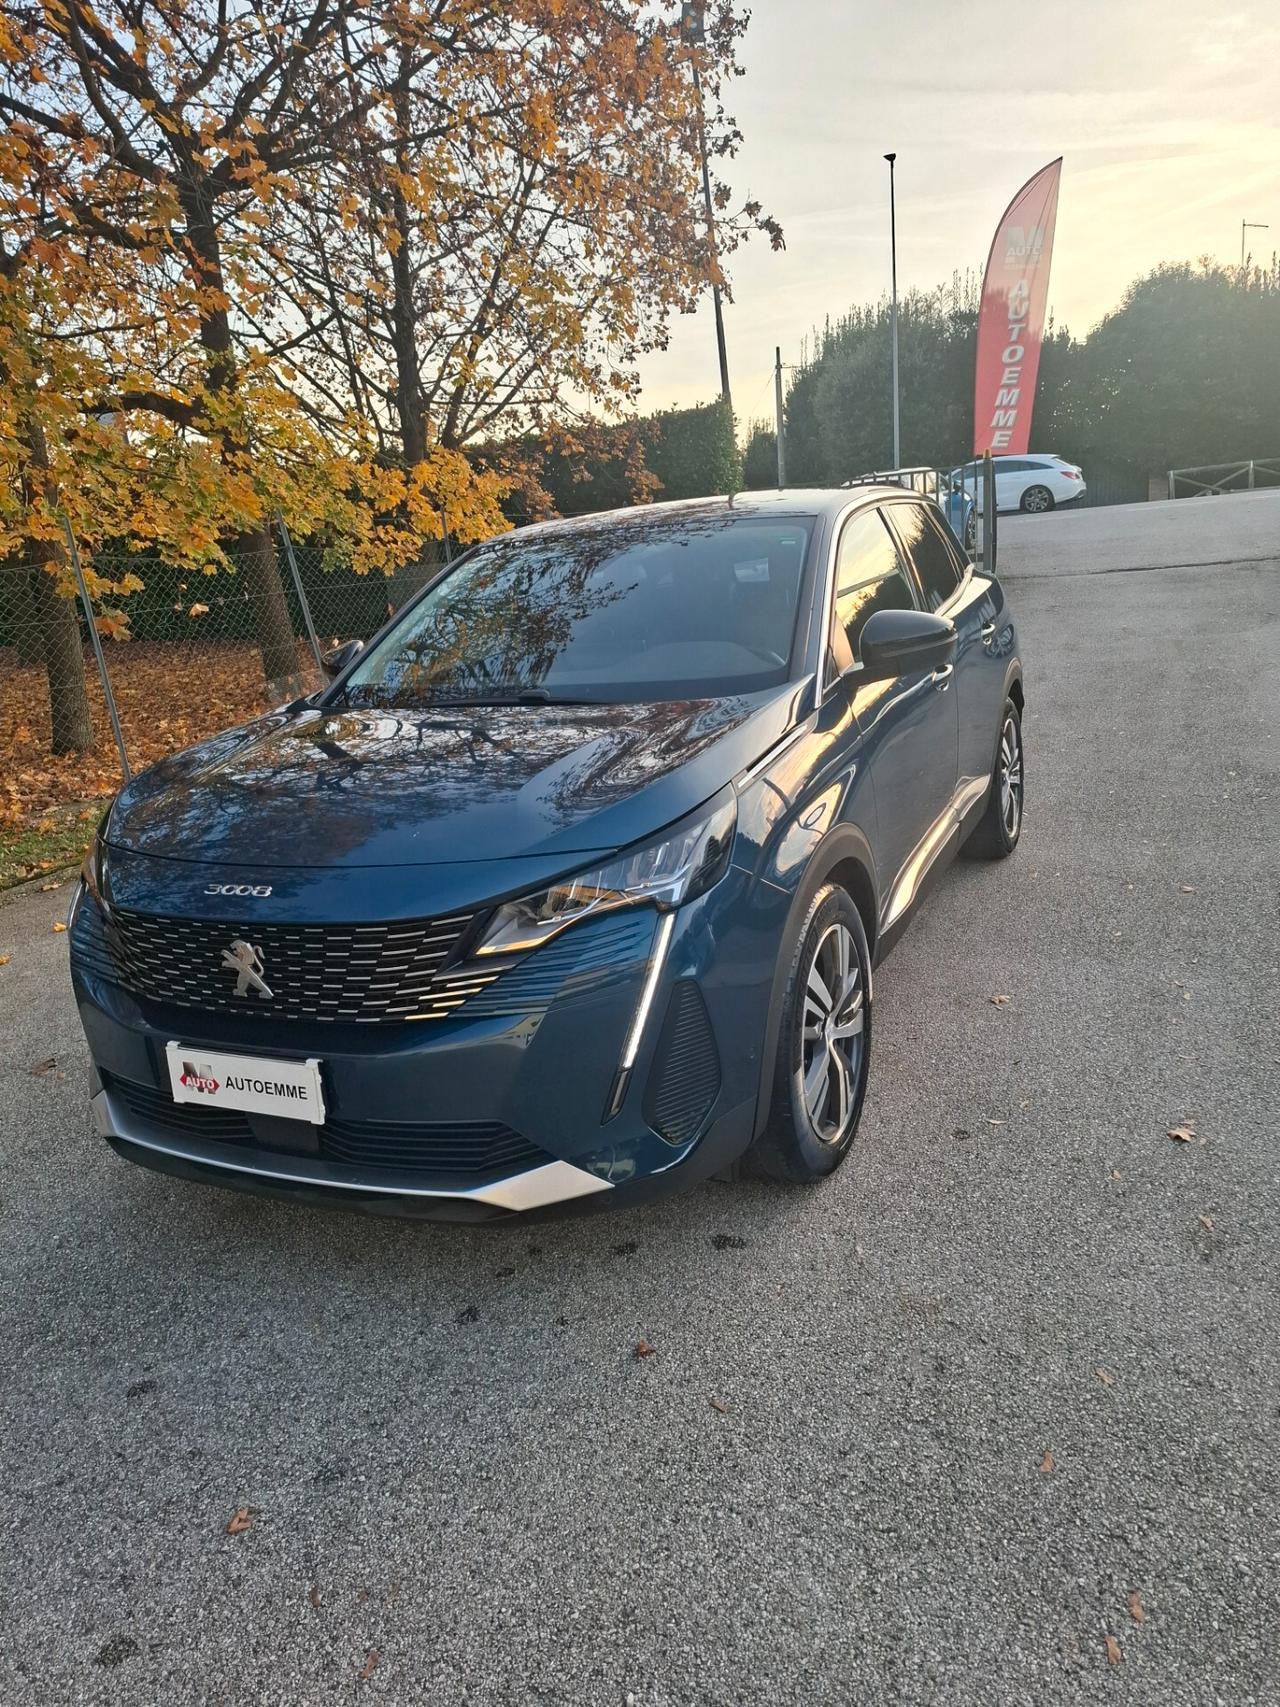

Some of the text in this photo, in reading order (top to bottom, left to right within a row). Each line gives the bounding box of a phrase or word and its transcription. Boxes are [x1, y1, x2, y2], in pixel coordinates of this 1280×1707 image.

[991, 279, 1029, 449] AUTOEMME
[203, 883, 273, 897] 3008
[185, 1075, 215, 1090] AUTO
[225, 1076, 308, 1100] AUTOEMME
